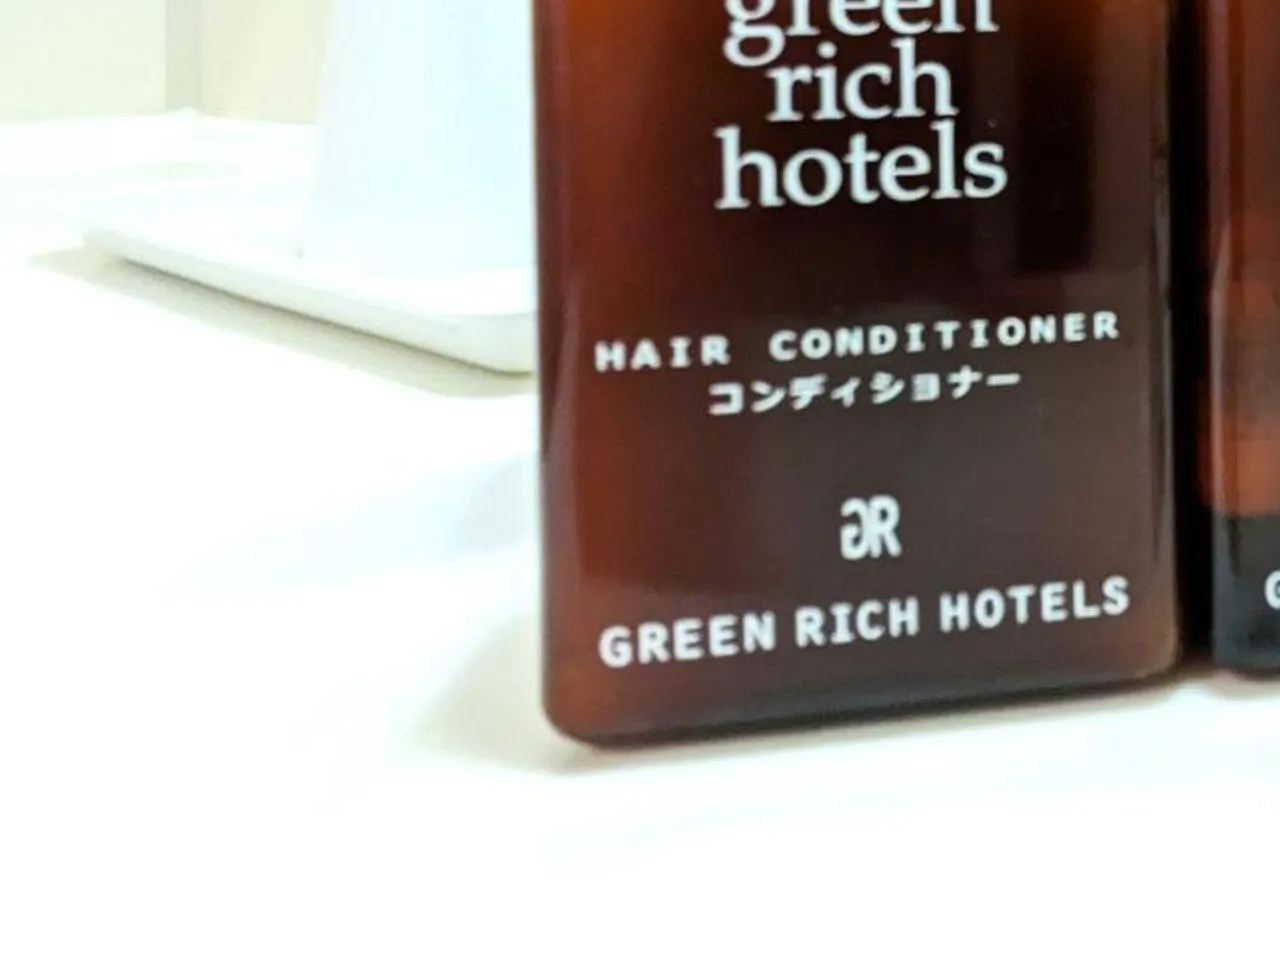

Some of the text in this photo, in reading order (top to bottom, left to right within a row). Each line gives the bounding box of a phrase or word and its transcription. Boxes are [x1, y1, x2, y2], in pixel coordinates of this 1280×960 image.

[764, 37, 958, 122] rich
[715, 119, 1008, 210] hotels
[595, 311, 1119, 372] HAIR CONDITIONER
[710, 365, 1021, 415] コンディショナー
[598, 576, 1129, 668] GREEN RICH HOTELS
